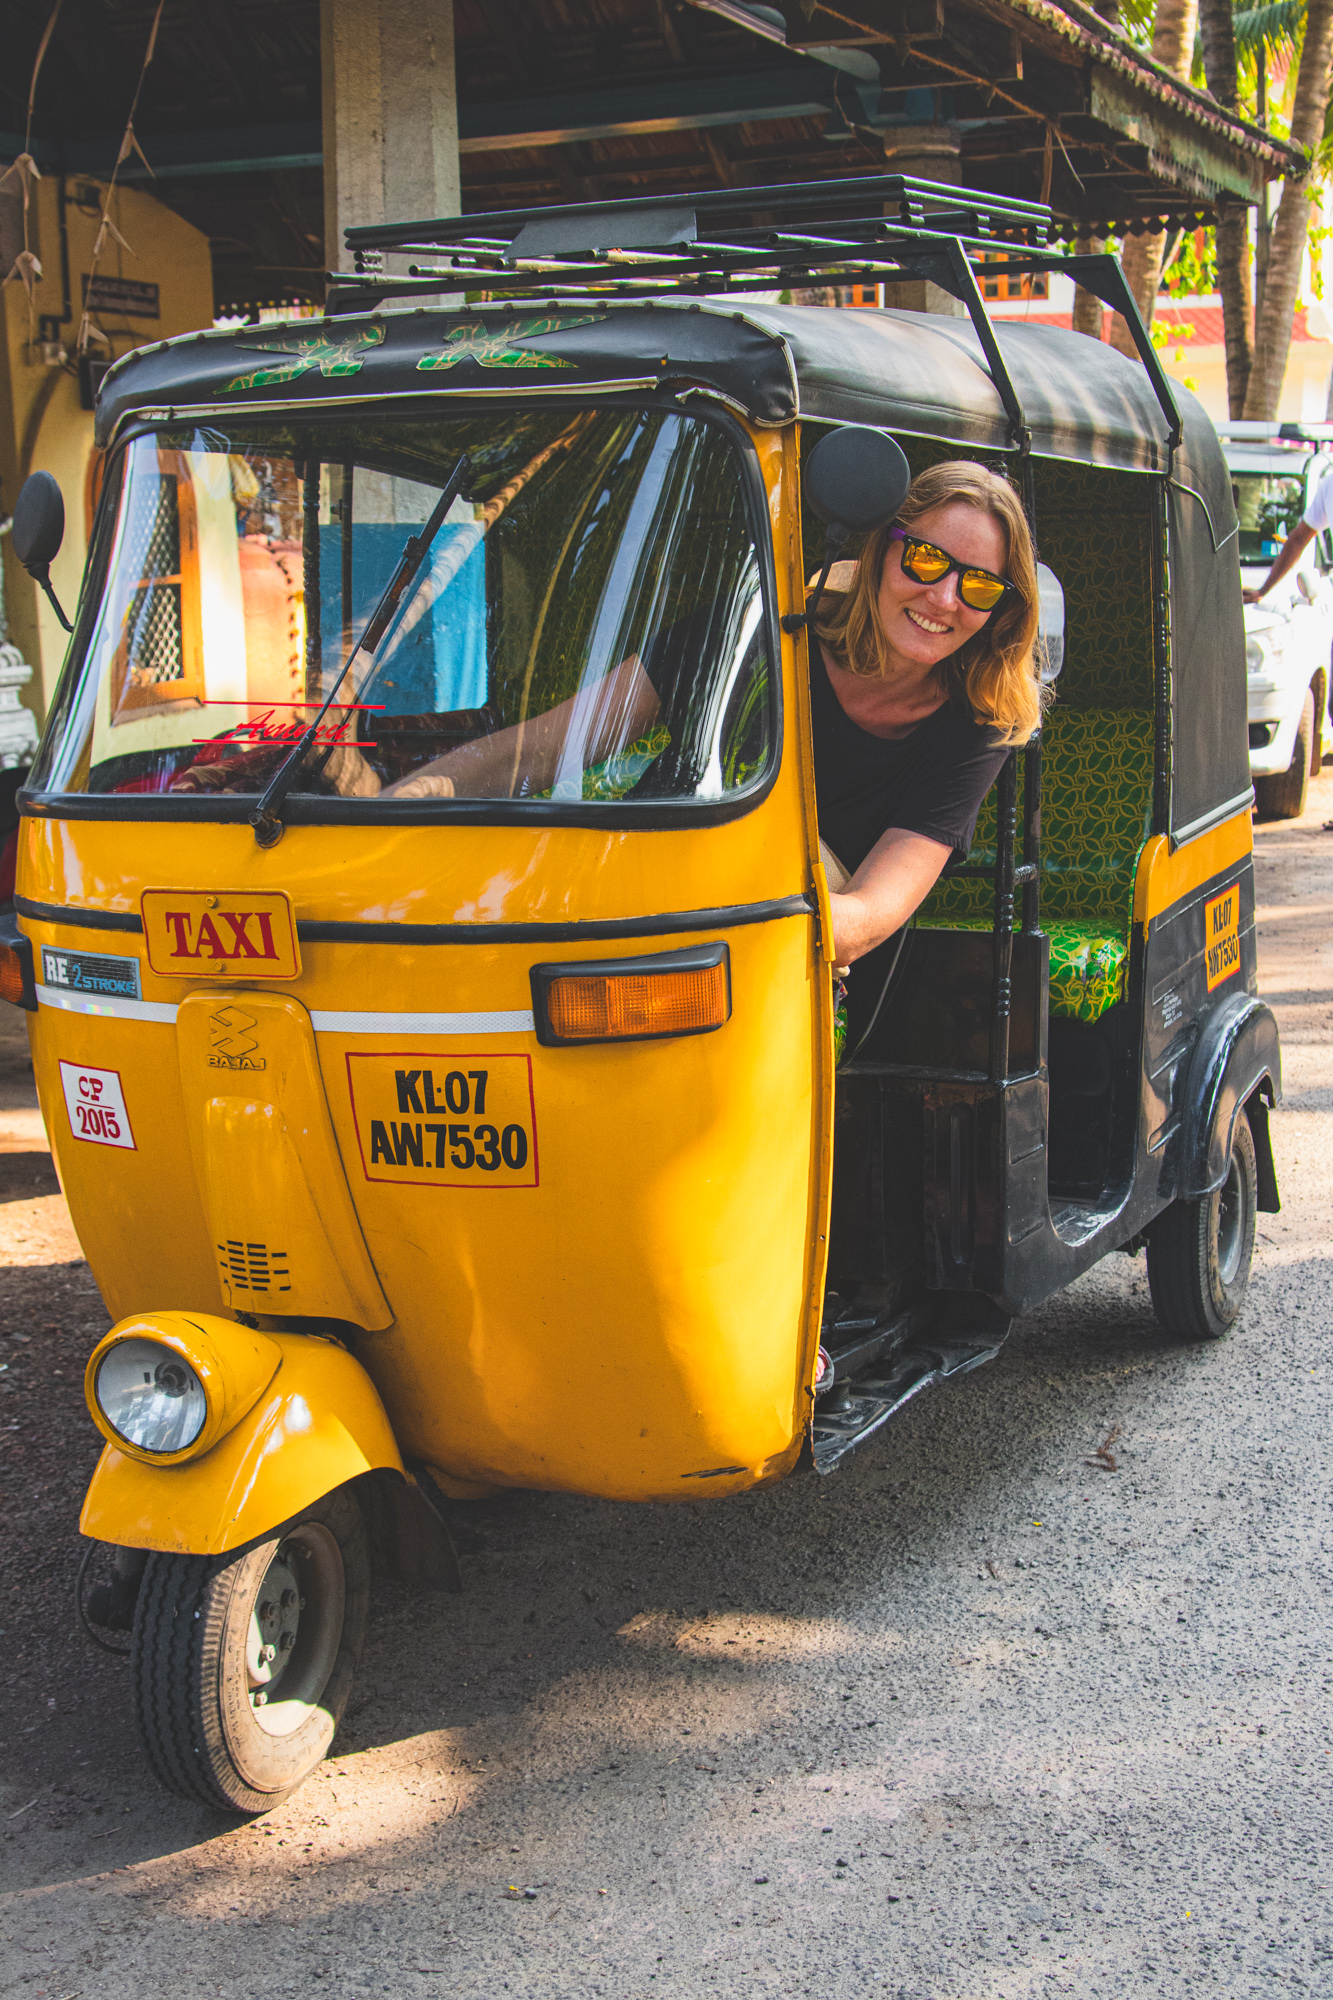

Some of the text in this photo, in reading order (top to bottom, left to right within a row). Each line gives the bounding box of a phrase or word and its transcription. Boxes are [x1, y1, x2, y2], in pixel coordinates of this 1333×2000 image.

[165, 911, 281, 960] TAXI
[45, 954, 70, 985] RE
[207, 1054, 267, 1071] BAJAJ
[78, 1075, 104, 1102] CP
[76, 1105, 121, 1139] 2015
